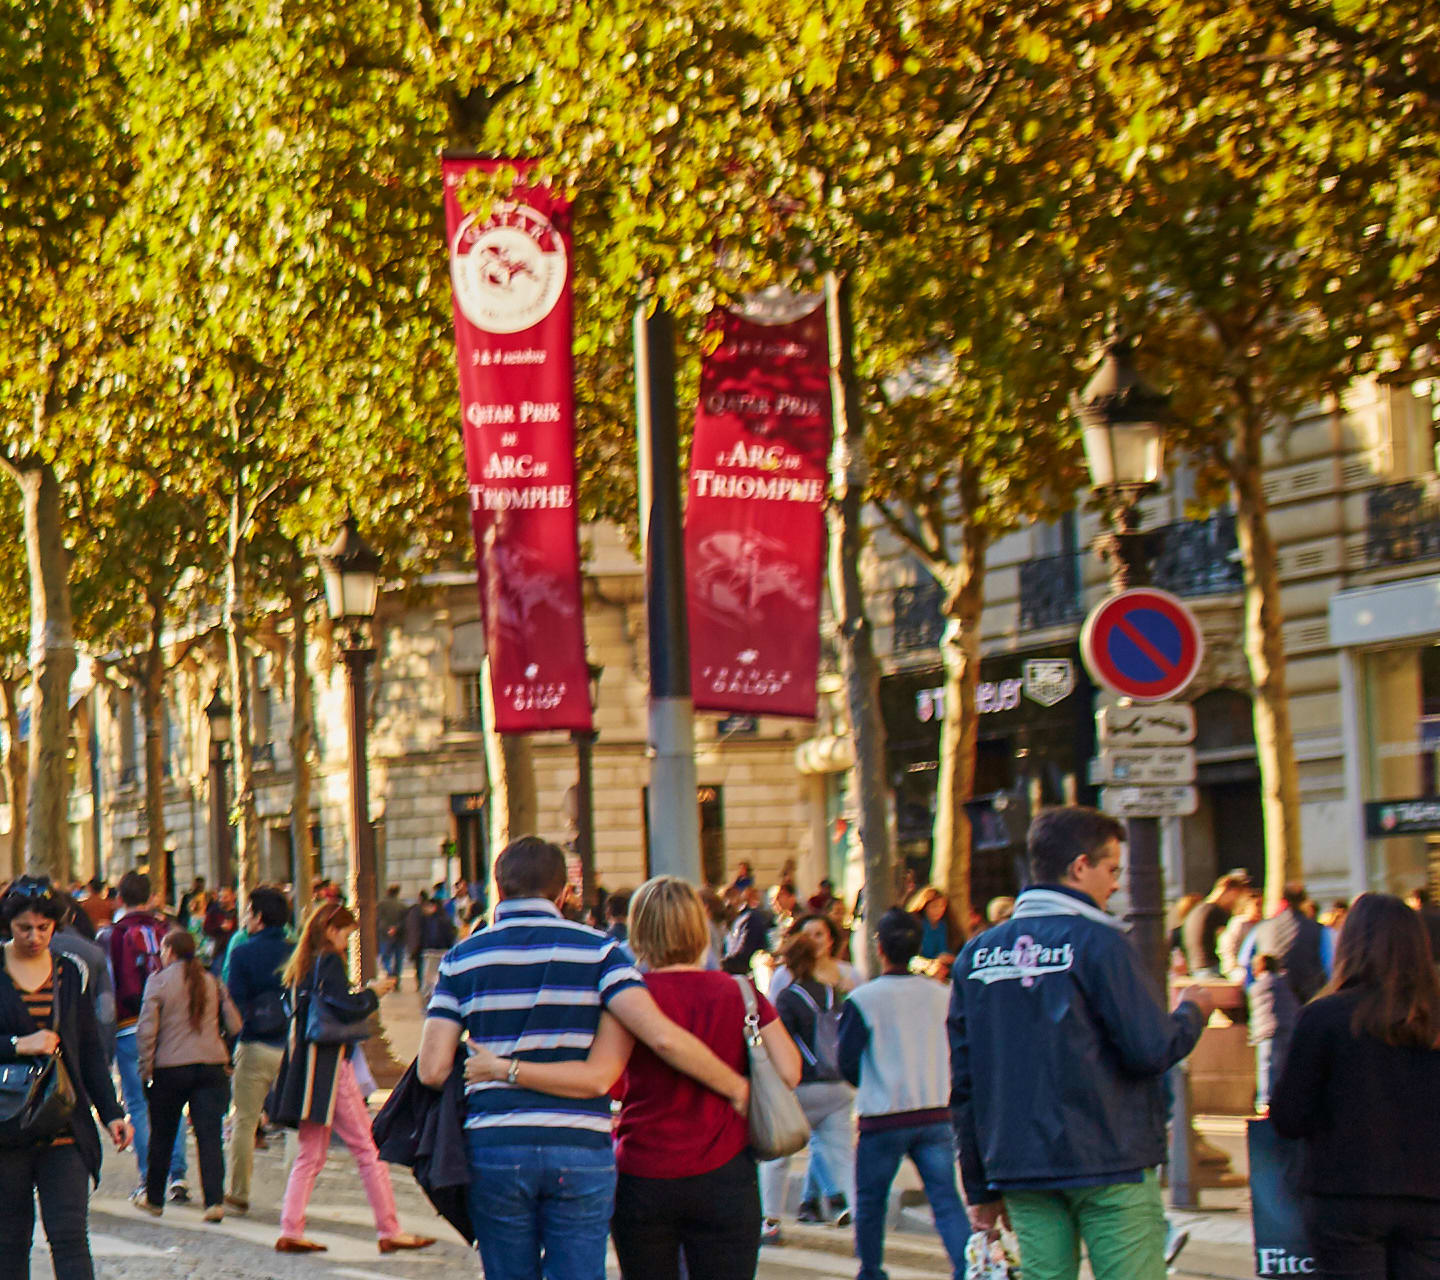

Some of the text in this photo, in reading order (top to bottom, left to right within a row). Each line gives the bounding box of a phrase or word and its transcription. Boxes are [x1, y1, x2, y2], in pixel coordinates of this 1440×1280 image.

[503, 347, 548, 366] octobre
[466, 399, 561, 429] QATAR PRIX
[706, 390, 822, 418] QATAR PRIX
[468, 483, 573, 512] TRIOMPHE
[693, 470, 825, 503] TRIOMPHE
[712, 677, 781, 696] GALOP
[972, 943, 1075, 969] Eden Park
[1257, 1247, 1317, 1275] Fitc
